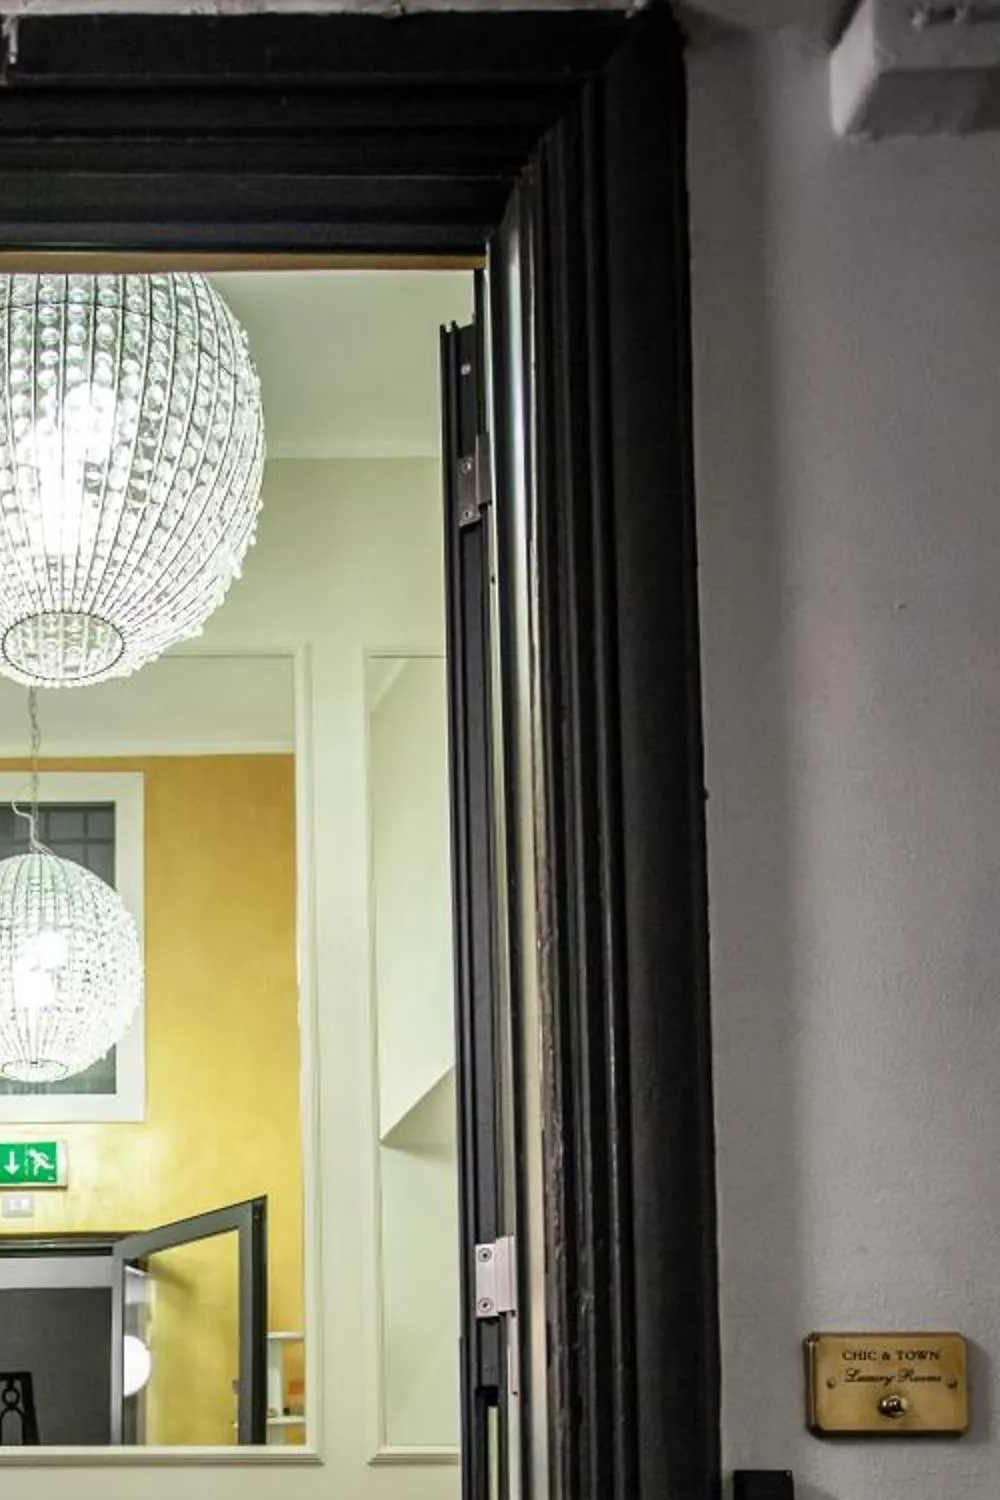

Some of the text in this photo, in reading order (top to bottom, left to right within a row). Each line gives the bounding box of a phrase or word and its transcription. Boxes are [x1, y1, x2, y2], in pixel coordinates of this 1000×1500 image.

[841, 1350, 940, 1361] CHIC & TOWN
